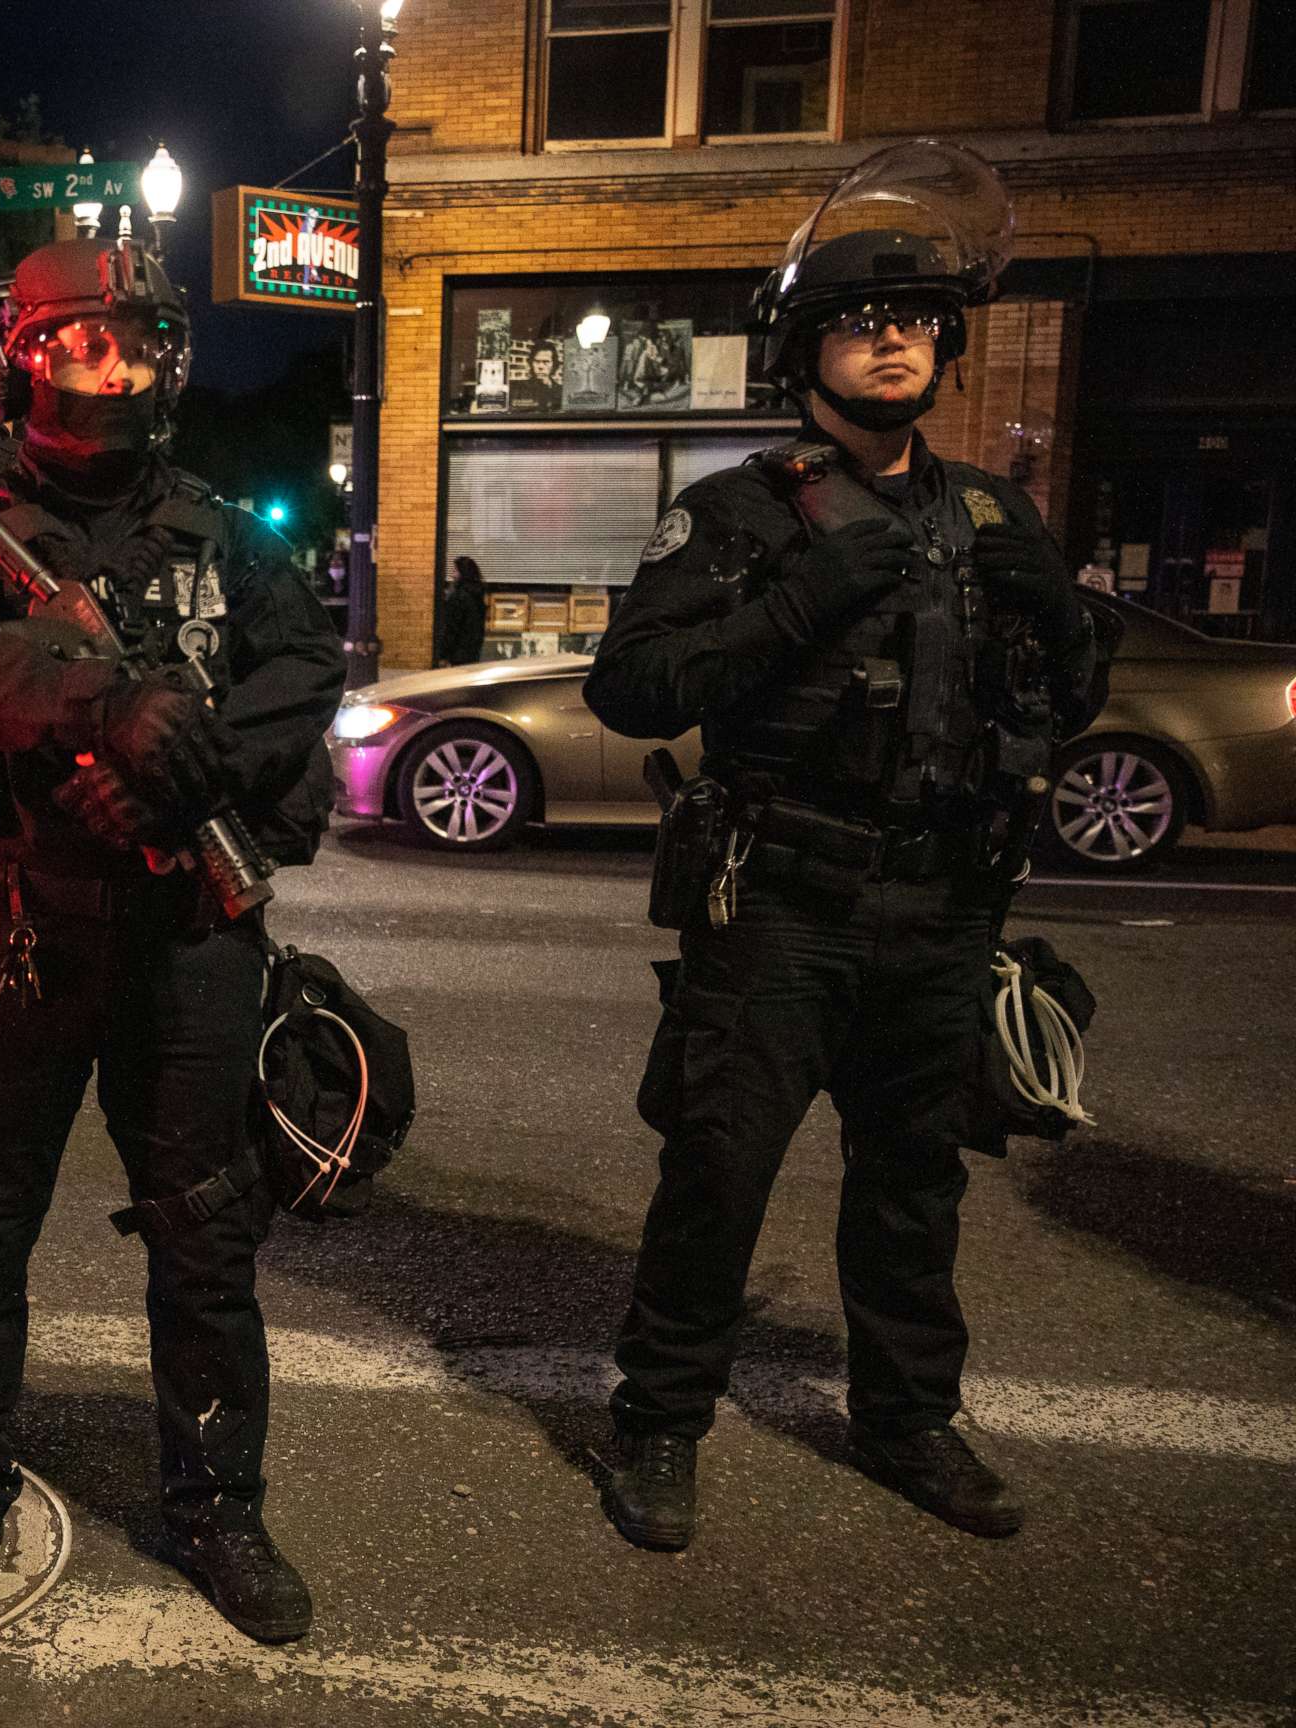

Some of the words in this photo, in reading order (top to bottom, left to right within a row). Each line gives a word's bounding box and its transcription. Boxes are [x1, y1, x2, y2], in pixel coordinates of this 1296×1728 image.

[32, 181, 55, 199] SW
[65, 173, 93, 198] 2nd
[103, 179, 124, 197] Av
[252, 231, 293, 273] 2nd
[297, 232, 360, 280] AVENU
[268, 266, 355, 287] RECORDS
